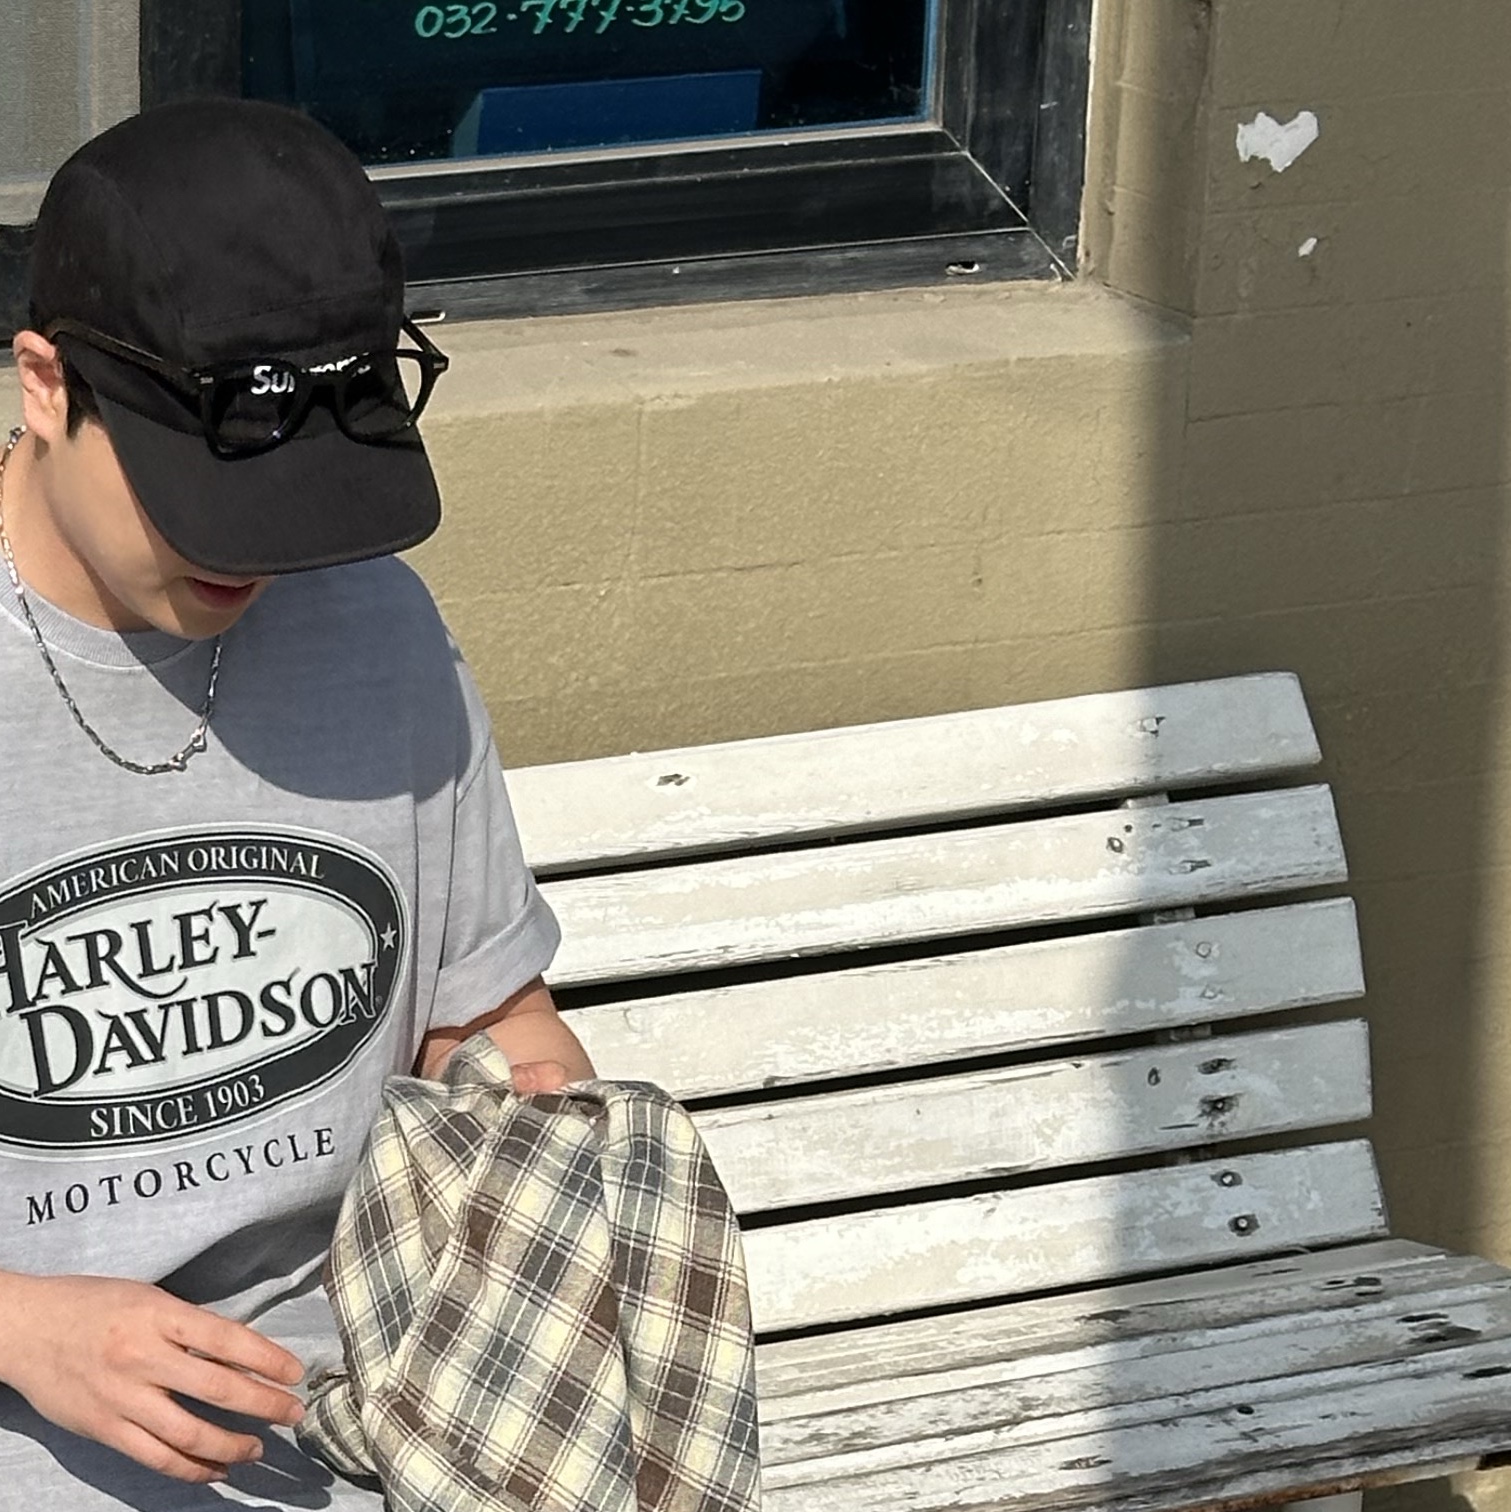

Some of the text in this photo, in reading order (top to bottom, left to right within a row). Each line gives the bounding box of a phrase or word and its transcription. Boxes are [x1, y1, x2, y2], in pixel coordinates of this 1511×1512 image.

[29, 846, 326, 920] AMERICAN ORIGINAL
[20, 961, 379, 1098] DAVIDSON
[90, 1075, 266, 1138] SINCE 1903
[26, 1127, 336, 1226] MOTORCYCLE
